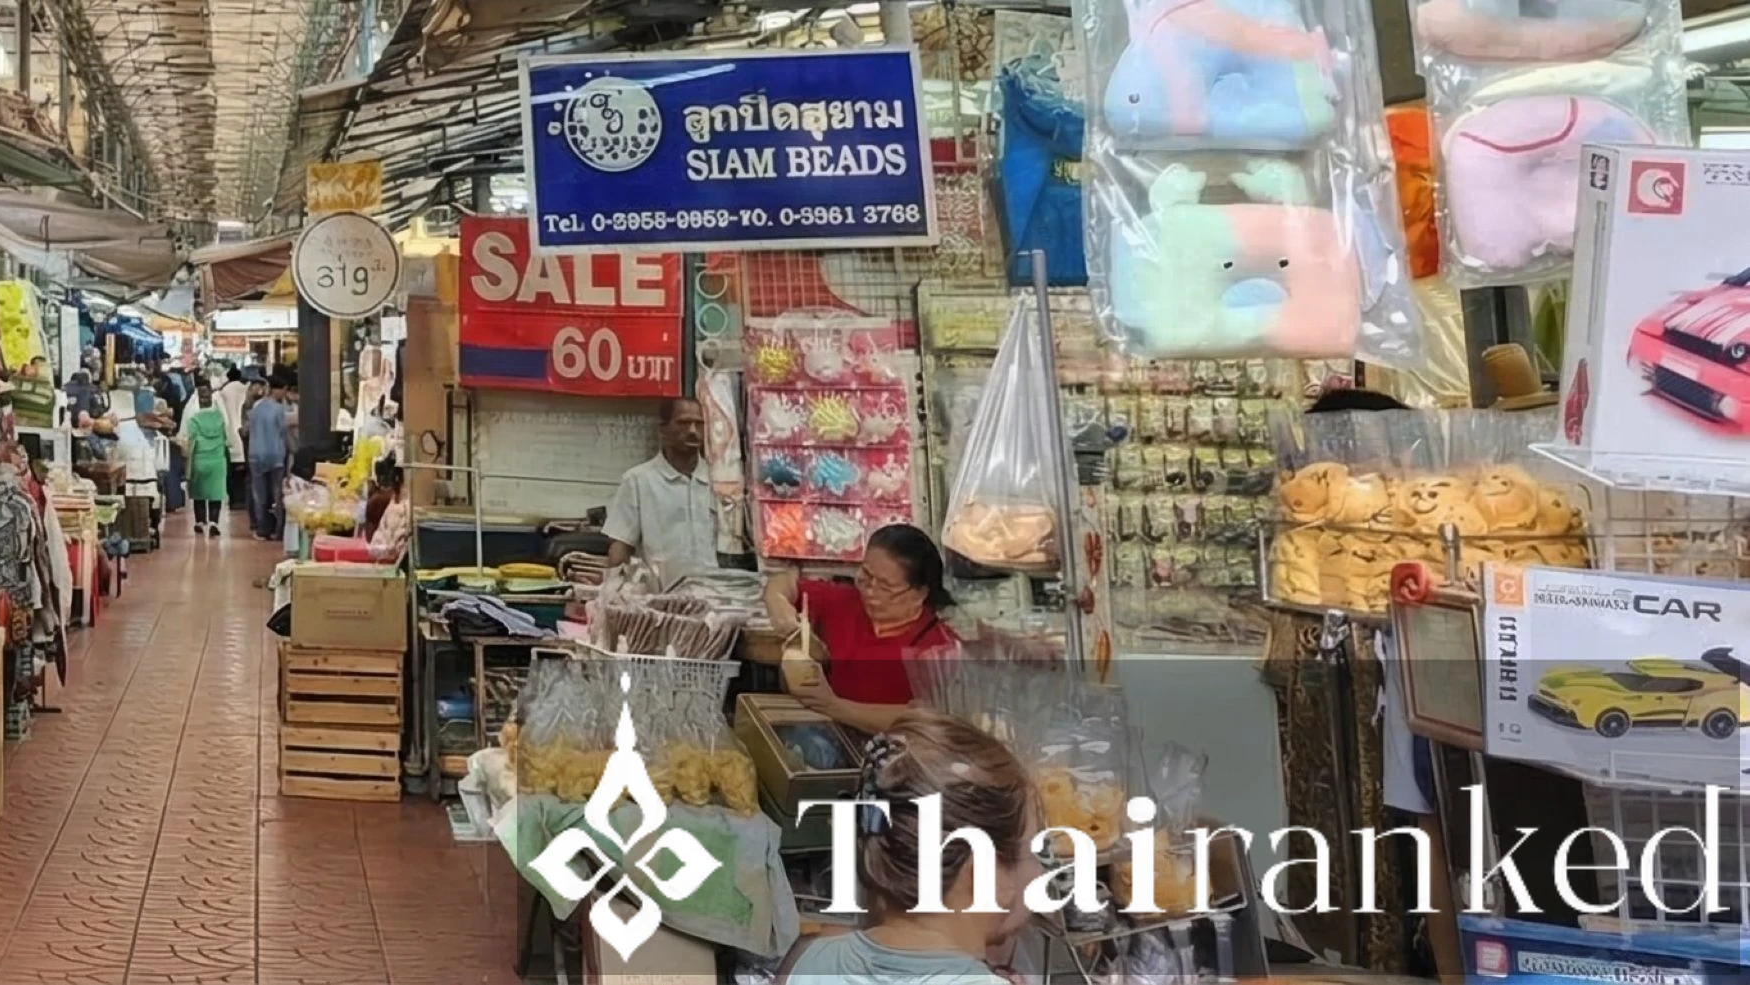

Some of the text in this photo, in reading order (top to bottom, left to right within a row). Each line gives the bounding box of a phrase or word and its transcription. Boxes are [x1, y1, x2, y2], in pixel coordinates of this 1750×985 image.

[687, 144, 907, 181] SIAM BEADS
[471, 231, 666, 307] SALE
[552, 326, 622, 381] 60
[1633, 594, 1722, 623] CAR
